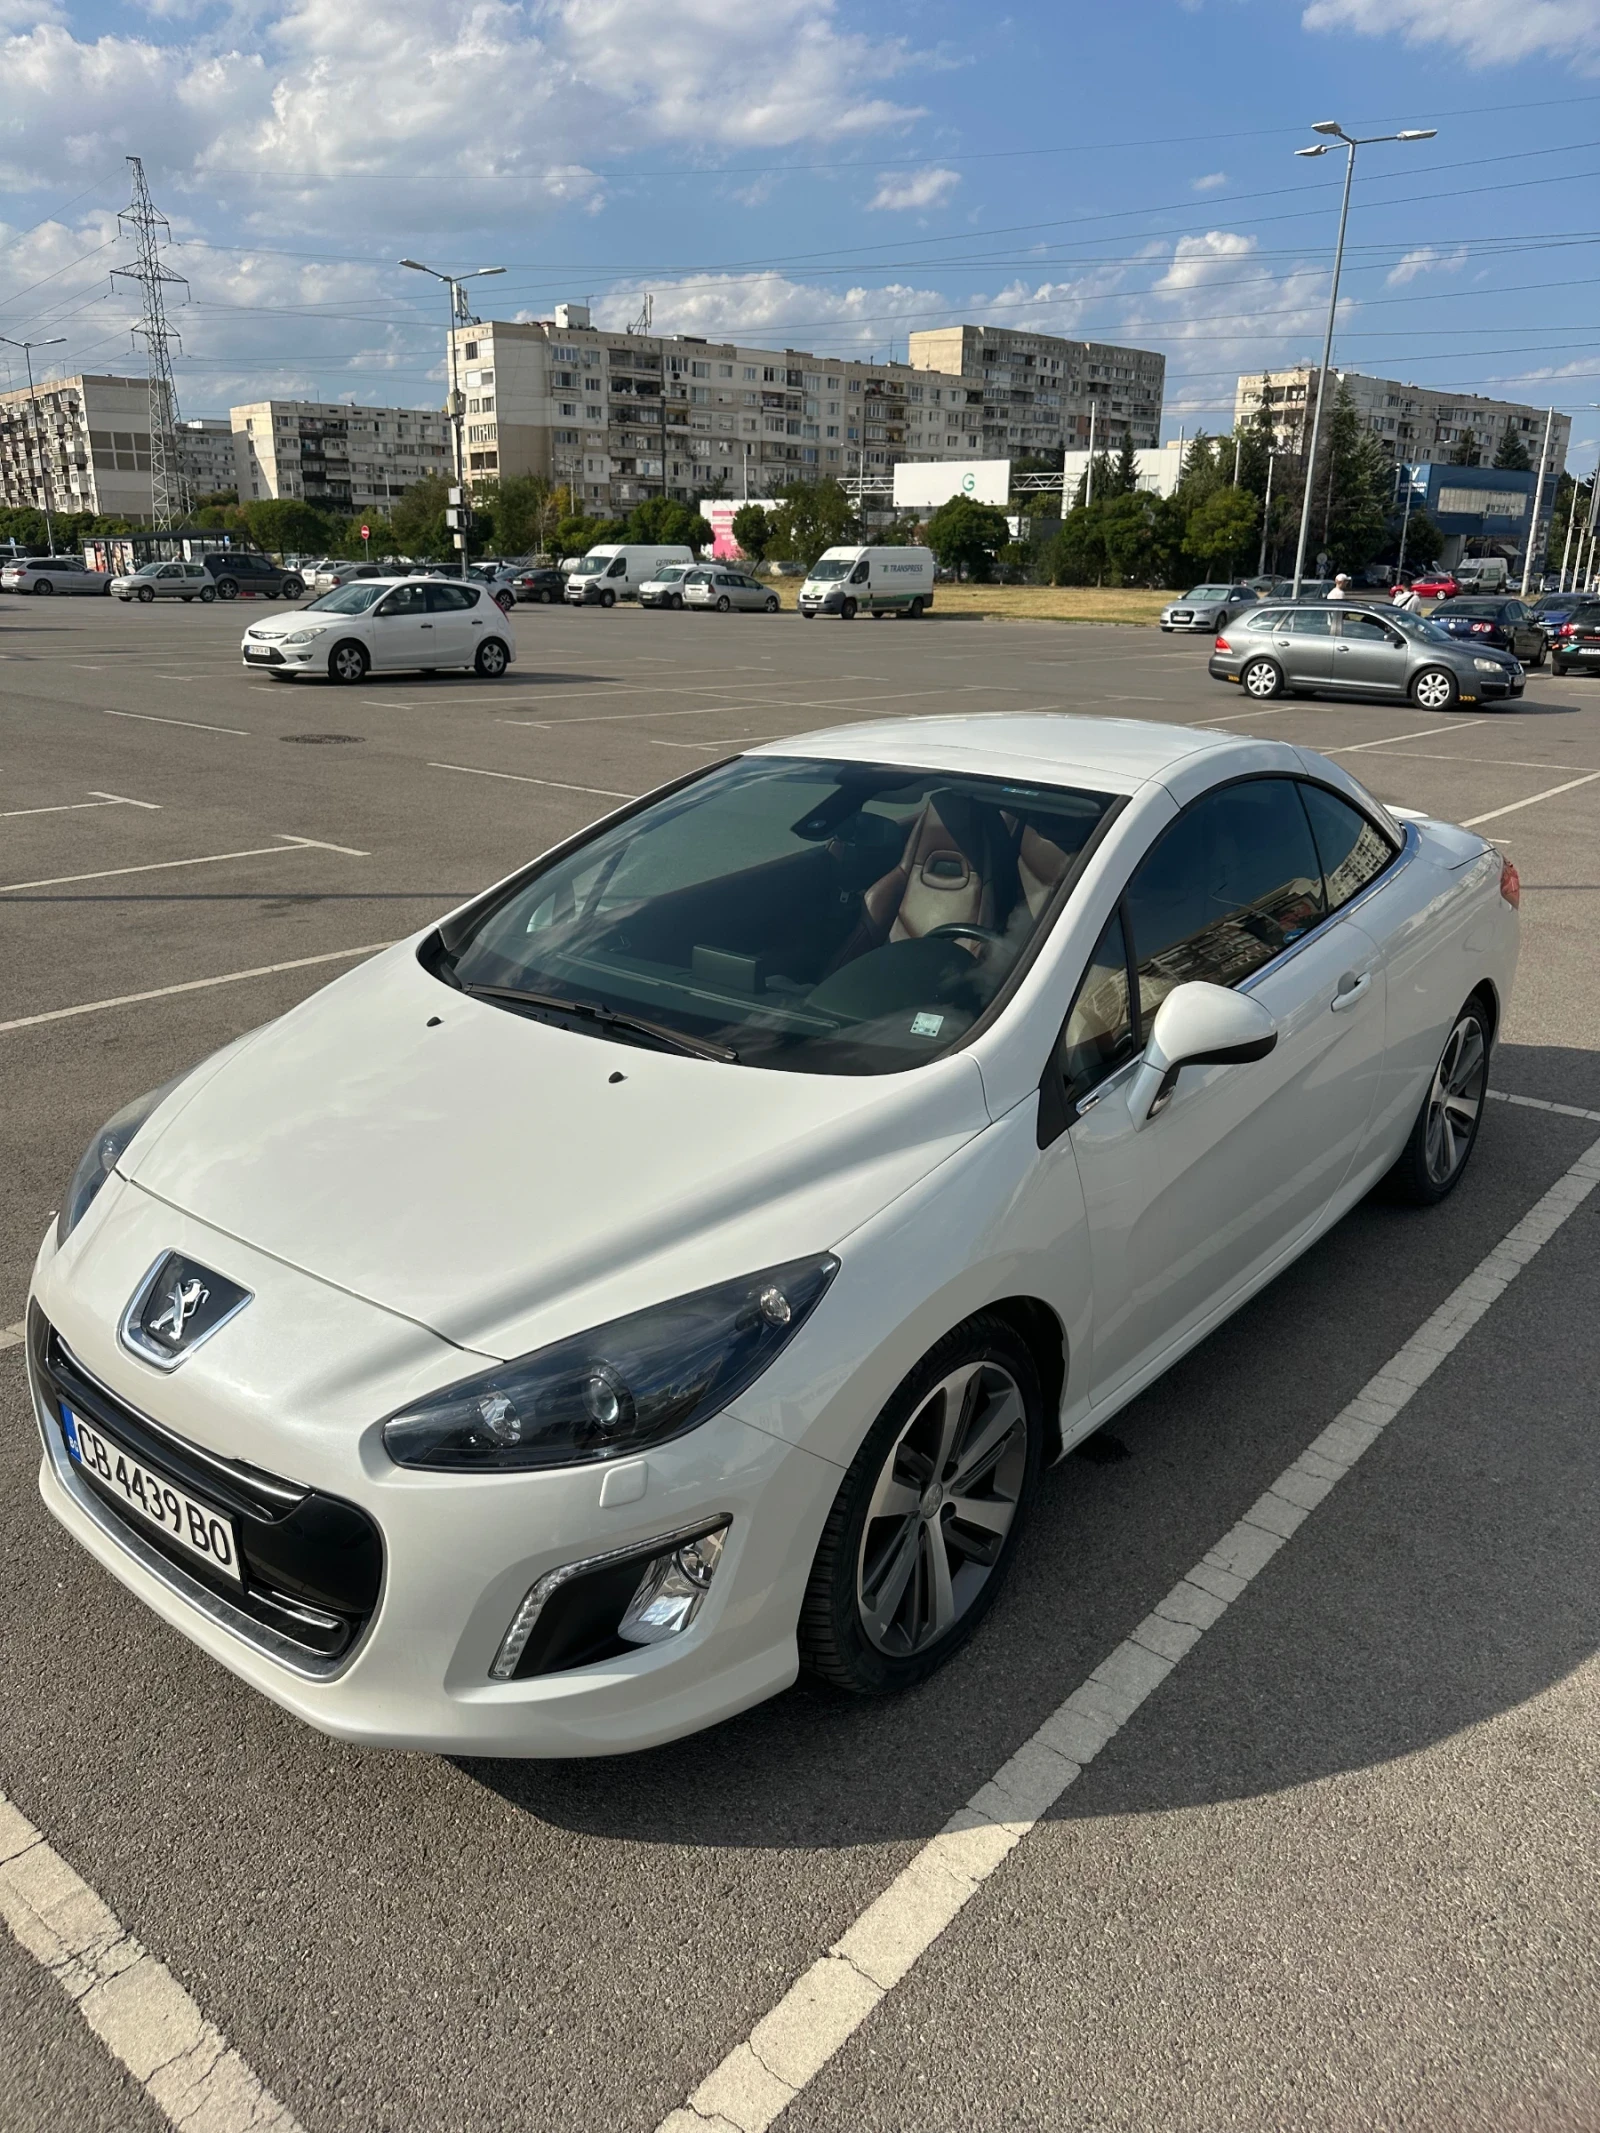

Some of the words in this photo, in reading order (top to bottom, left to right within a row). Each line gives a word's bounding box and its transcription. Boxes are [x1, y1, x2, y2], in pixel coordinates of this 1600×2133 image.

[890, 564, 923, 573] TRANSPRESS
[68, 1436, 79, 1452] BG
[78, 1423, 112, 1482] CB
[116, 1456, 182, 1534] 4439
